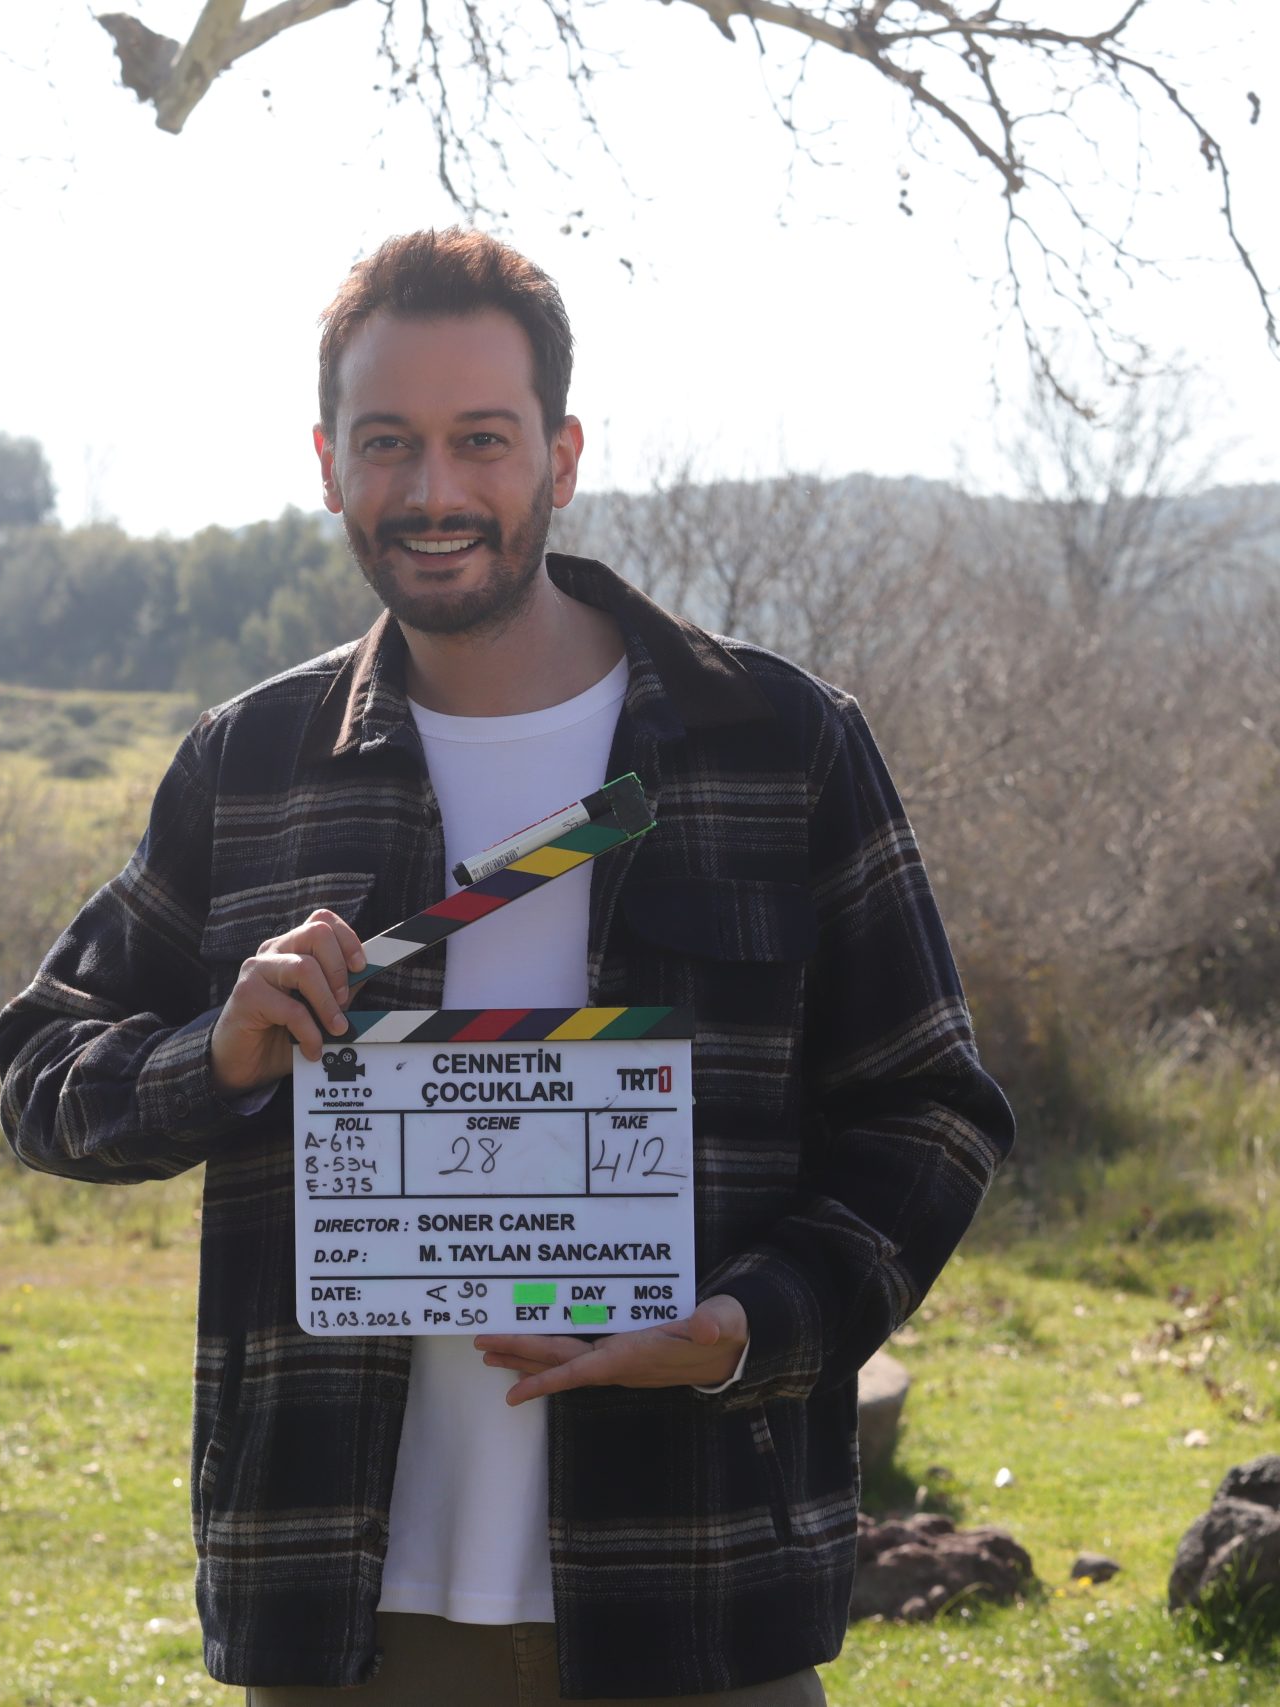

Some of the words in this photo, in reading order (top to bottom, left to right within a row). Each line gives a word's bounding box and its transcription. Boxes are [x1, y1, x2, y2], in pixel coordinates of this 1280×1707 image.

[432, 1048, 562, 1074] CENNETİN
[314, 1087, 373, 1098] MOTTO
[421, 1081, 574, 1108] ÇOCUKLARI
[335, 1117, 373, 1131] ROLL
[466, 1116, 521, 1130] SCENE
[611, 1115, 648, 1129] TAKE
[438, 1136, 503, 1175] 28
[417, 1214, 494, 1232] SONER
[499, 1213, 576, 1231] CANER
[419, 1245, 443, 1262] M.
[448, 1244, 531, 1262] TAYLAN
[537, 1243, 672, 1261] SANCAKTAR
[311, 1287, 362, 1302] DATE:
[571, 1286, 606, 1300] DAY
[634, 1285, 673, 1300] MOS
[309, 1310, 412, 1328] 13.03.2026
[423, 1309, 451, 1325] Fps
[455, 1308, 488, 1326] 50
[515, 1306, 550, 1321] EXT
[630, 1305, 678, 1320] SYNC
